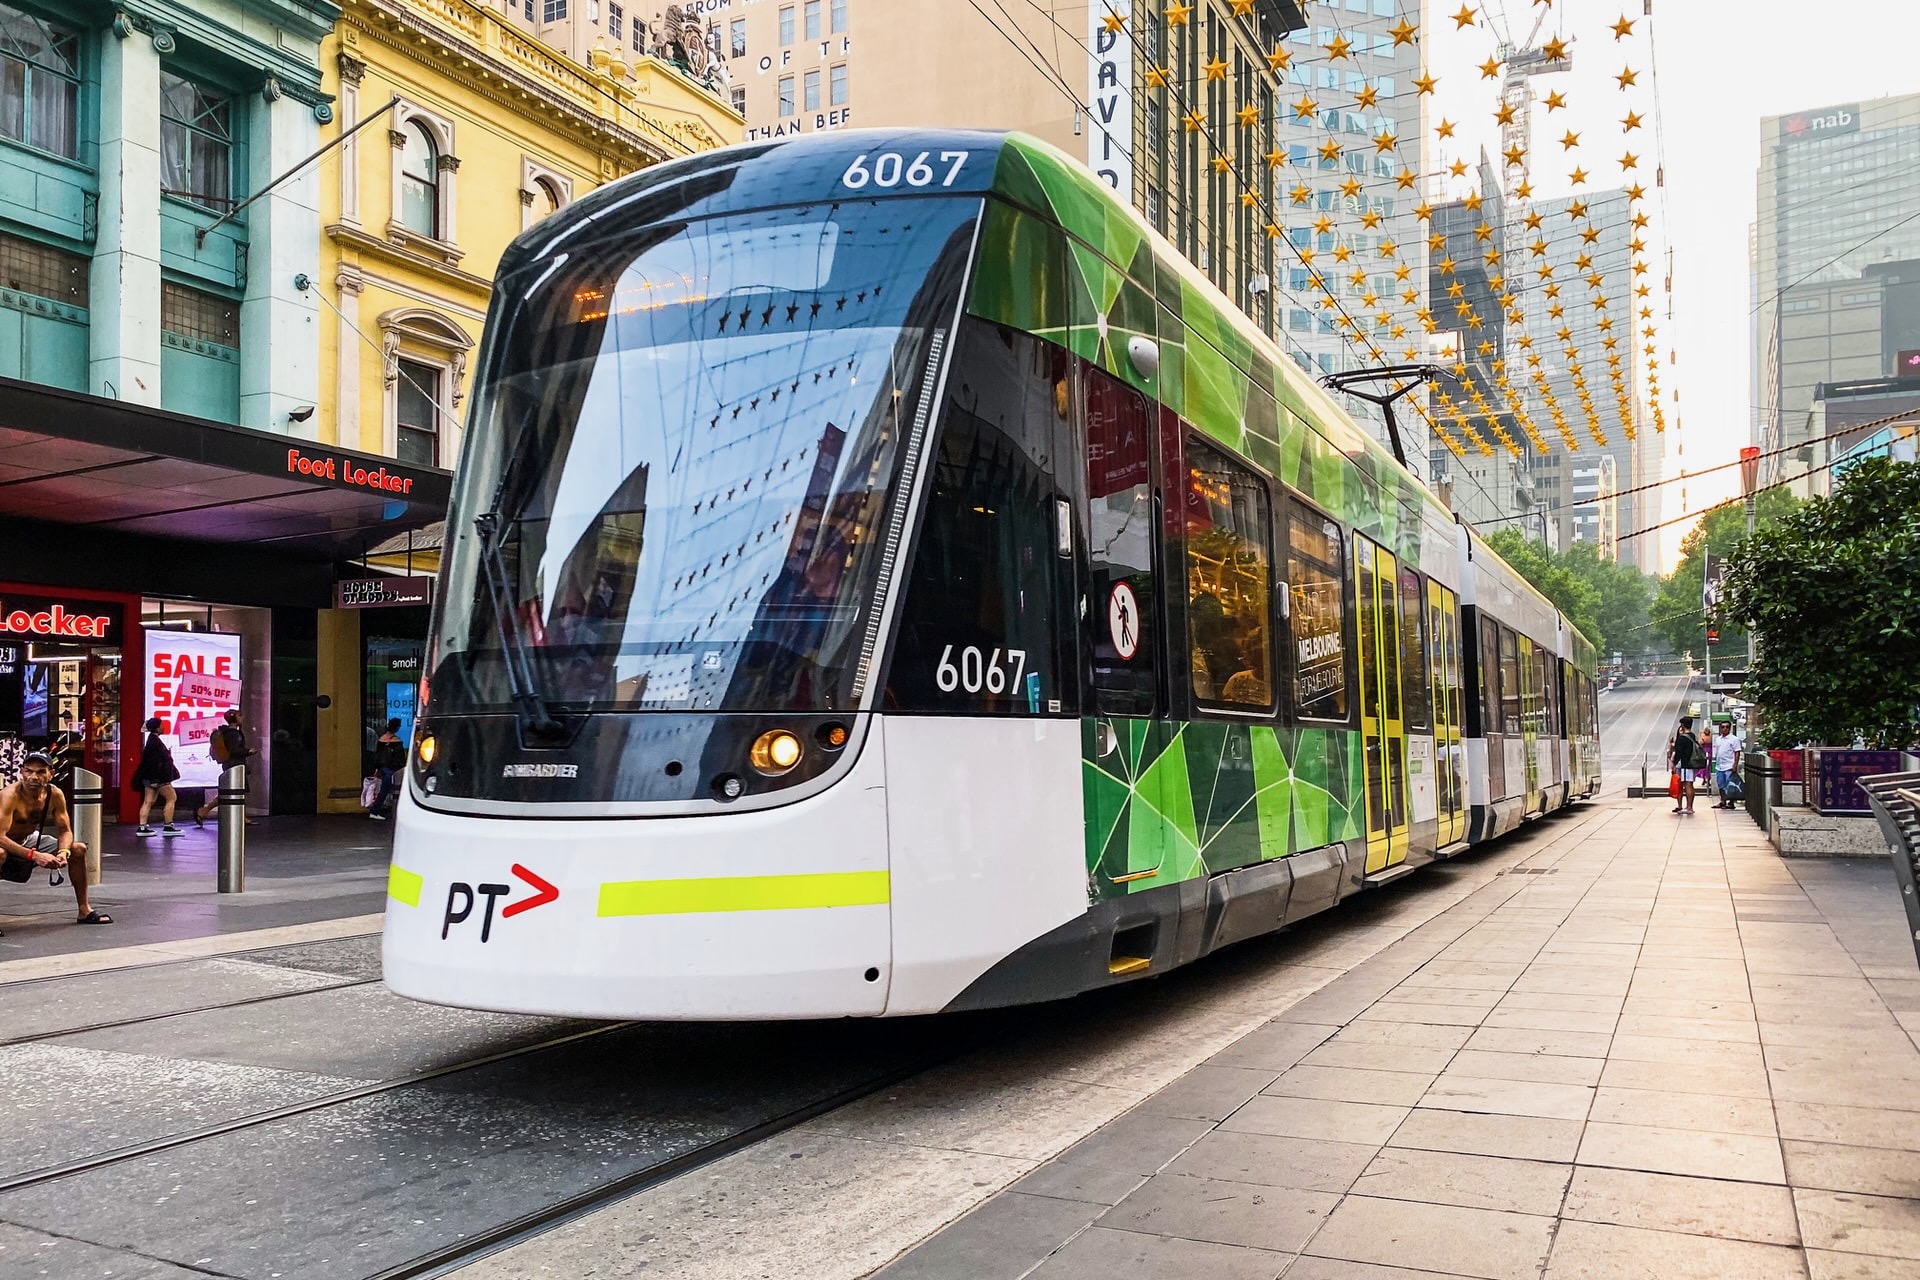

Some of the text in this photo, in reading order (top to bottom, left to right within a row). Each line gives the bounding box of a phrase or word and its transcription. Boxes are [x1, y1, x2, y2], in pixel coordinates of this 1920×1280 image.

[1811, 110, 1851, 131] nab
[842, 151, 969, 189] 6067
[288, 449, 413, 494] Foot Locker
[1299, 632, 1340, 664] MELBOURNE
[154, 653, 231, 679] SALE
[936, 644, 1026, 695] 6067
[154, 682, 231, 707] SA
[190, 684, 231, 699] 50% OFF
[154, 711, 226, 735] SA
[188, 729, 210, 740] 50%
